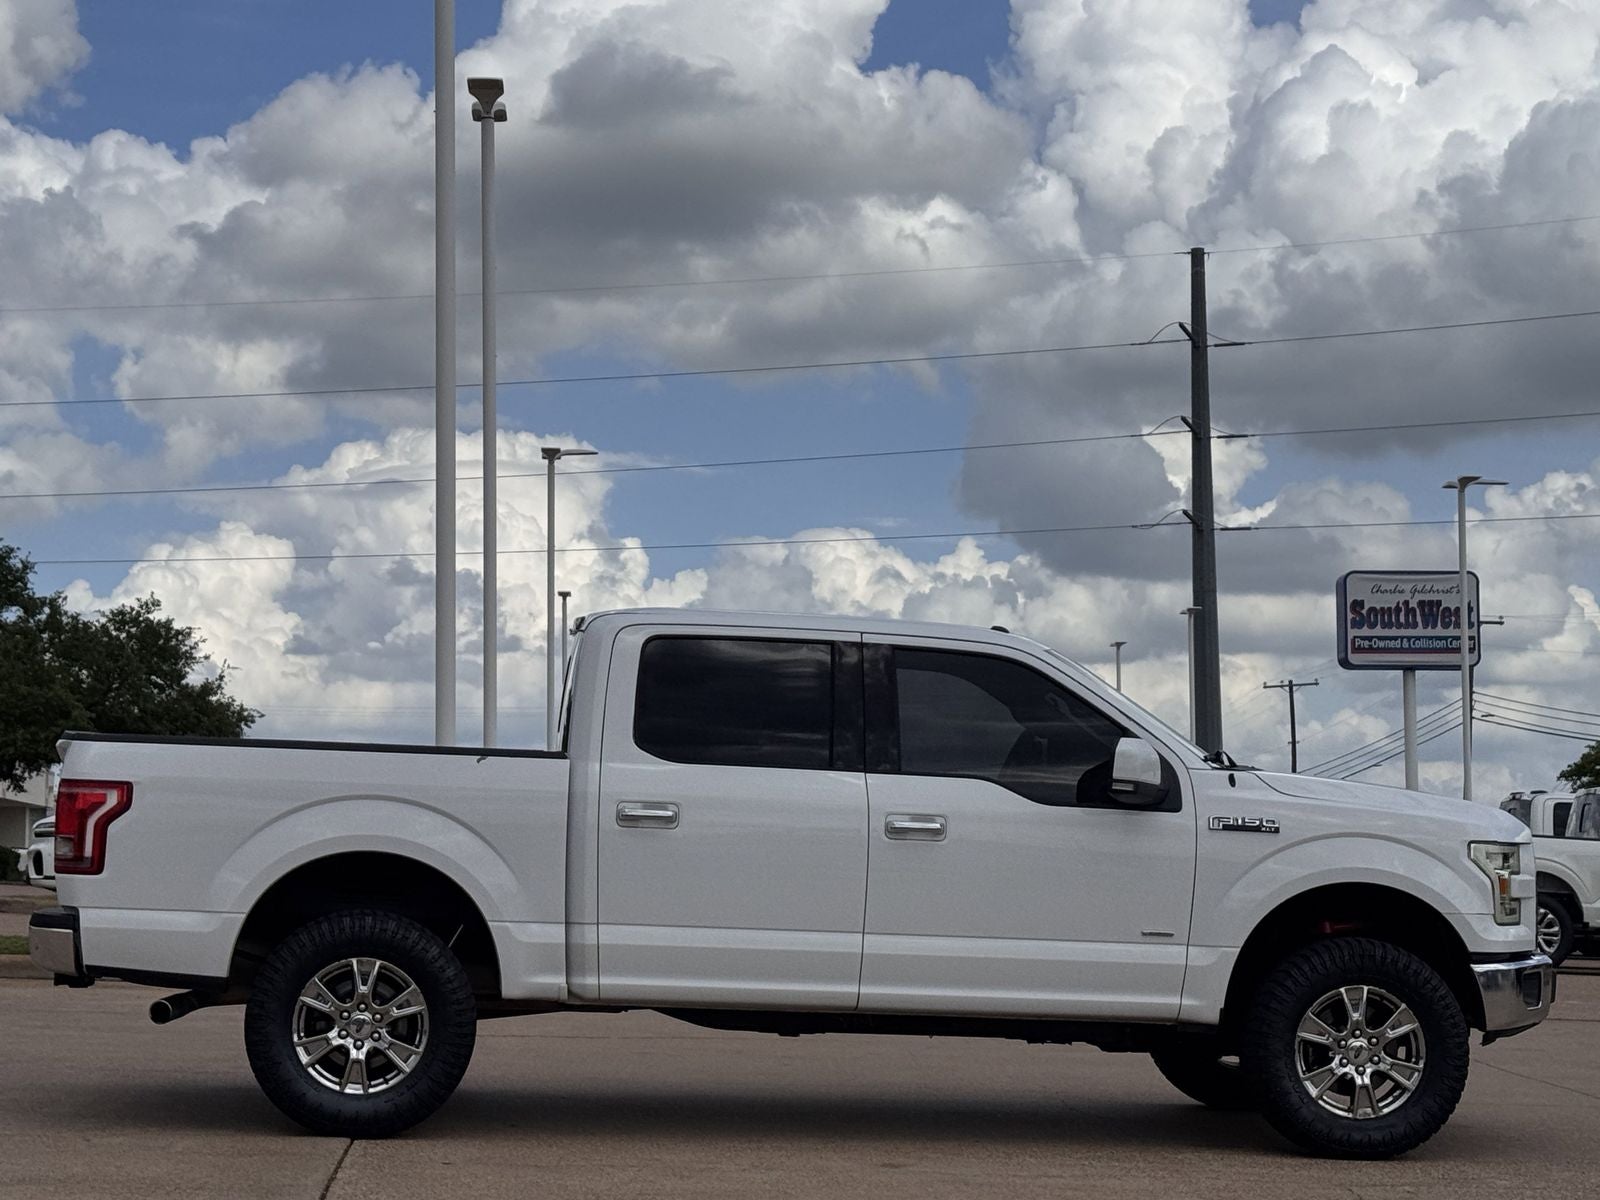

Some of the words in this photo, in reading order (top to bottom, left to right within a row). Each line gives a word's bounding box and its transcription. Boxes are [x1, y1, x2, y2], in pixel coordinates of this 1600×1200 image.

[1370, 583, 1405, 594] Charlie
[1410, 583, 1461, 599] Gilchrist's
[1355, 638, 1401, 648] Pre-Owned
[1402, 638, 1409, 648] &
[1410, 638, 1446, 648] Collision
